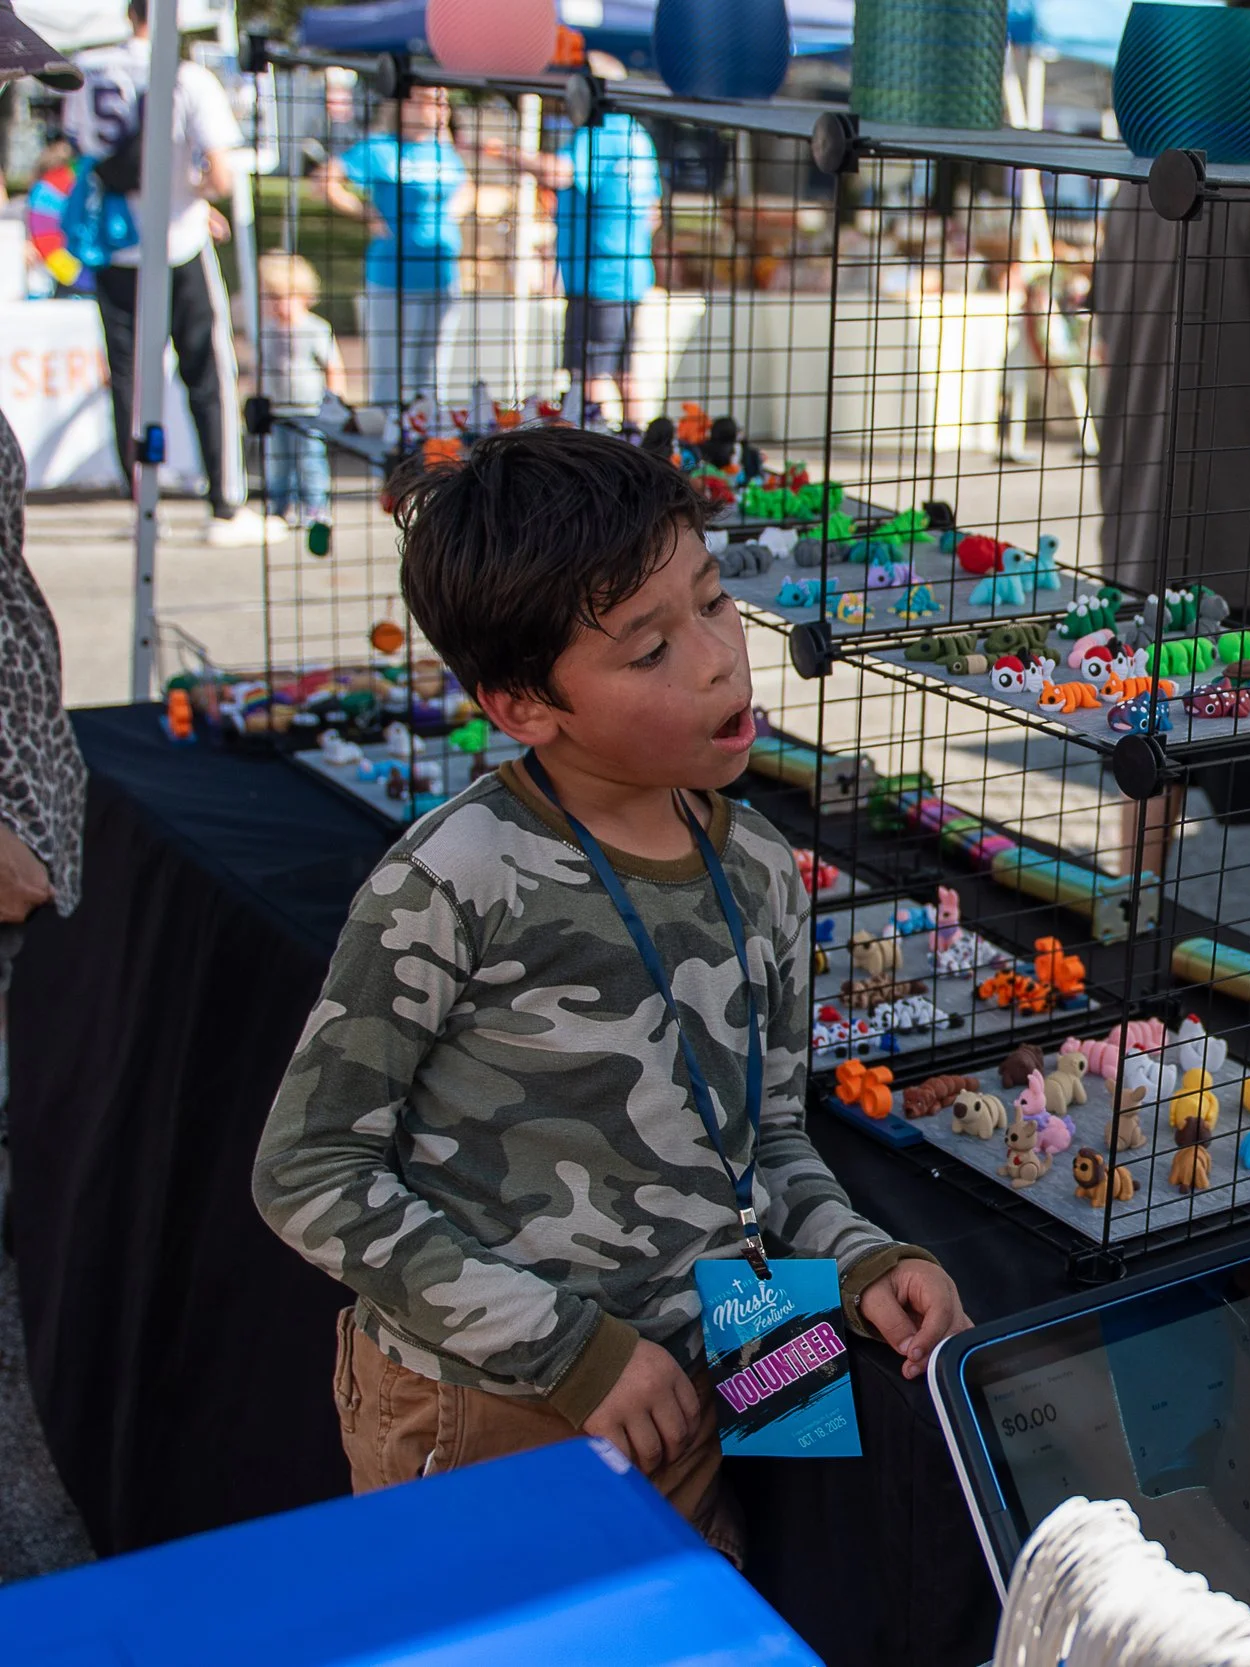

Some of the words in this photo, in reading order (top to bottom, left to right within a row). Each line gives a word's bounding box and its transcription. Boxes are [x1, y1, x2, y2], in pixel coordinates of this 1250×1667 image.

[713, 1281, 779, 1331] Music
[752, 1299, 796, 1332] Festival
[716, 1321, 847, 1414] VOLUNTEER
[798, 1432, 817, 1448] OCT.
[826, 1415, 847, 1433] 2025
[1001, 1402, 1057, 1437] $0.00
[1213, 1418, 1222, 1429] 3
[1228, 1458, 1236, 1470] 6
